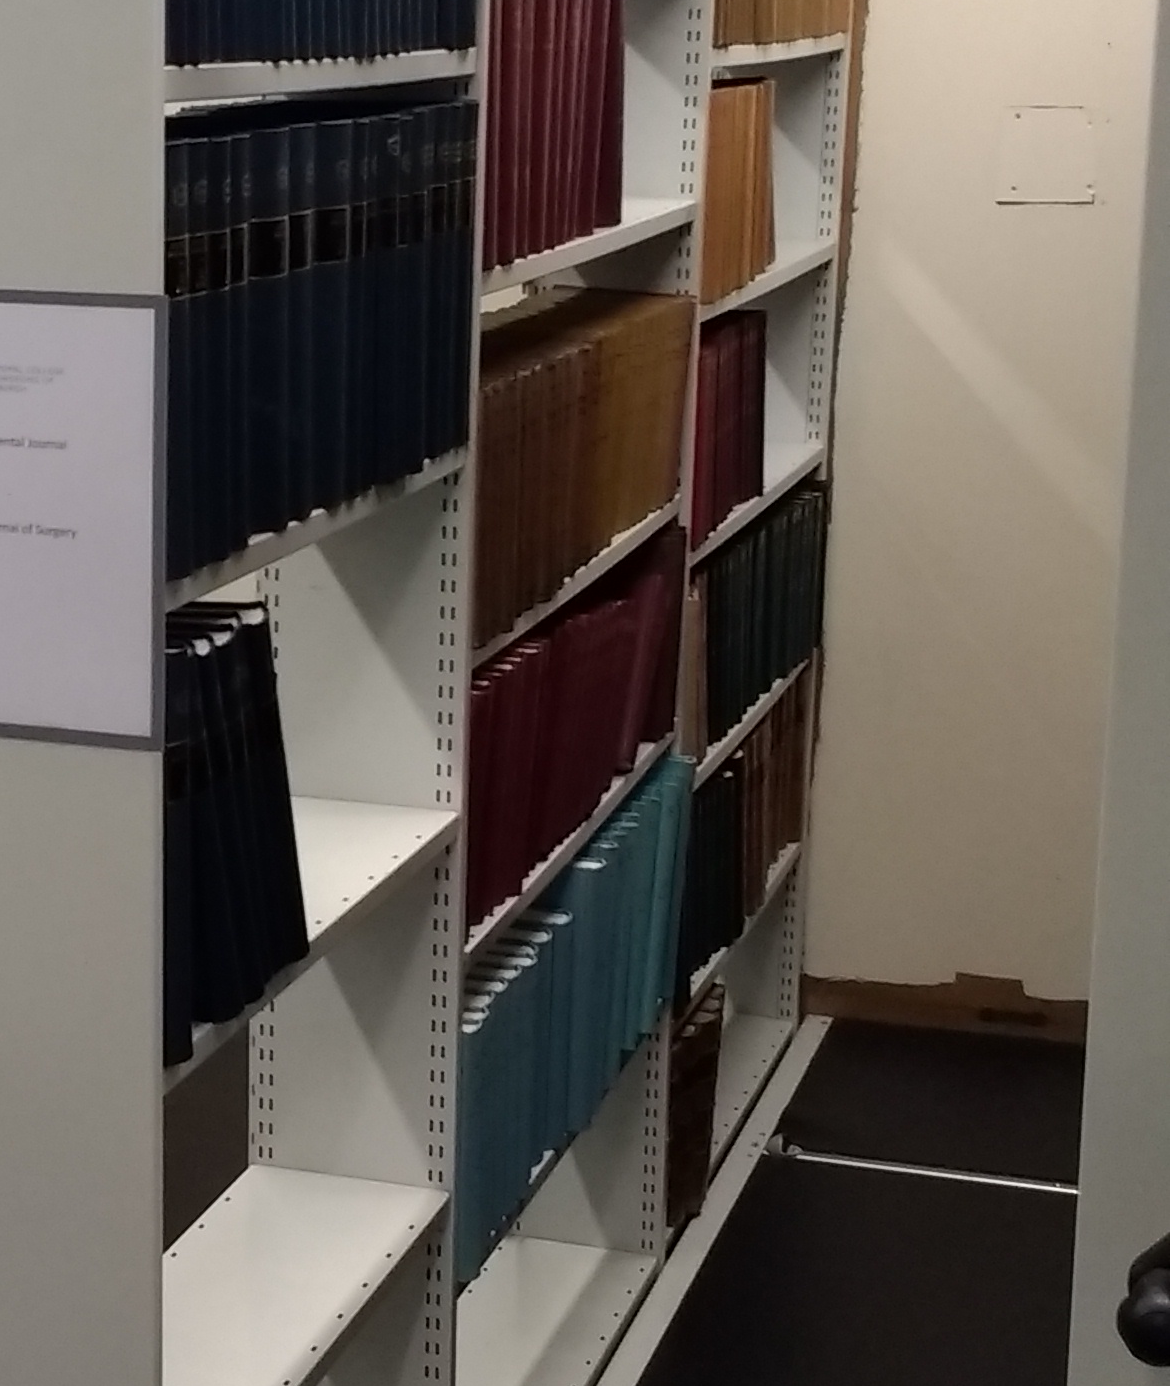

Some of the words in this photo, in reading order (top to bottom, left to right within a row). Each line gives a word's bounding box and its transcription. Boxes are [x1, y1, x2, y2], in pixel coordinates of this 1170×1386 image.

[27, 438, 67, 450] Journal
[21, 522, 33, 534] of
[35, 524, 77, 540] Surgery
